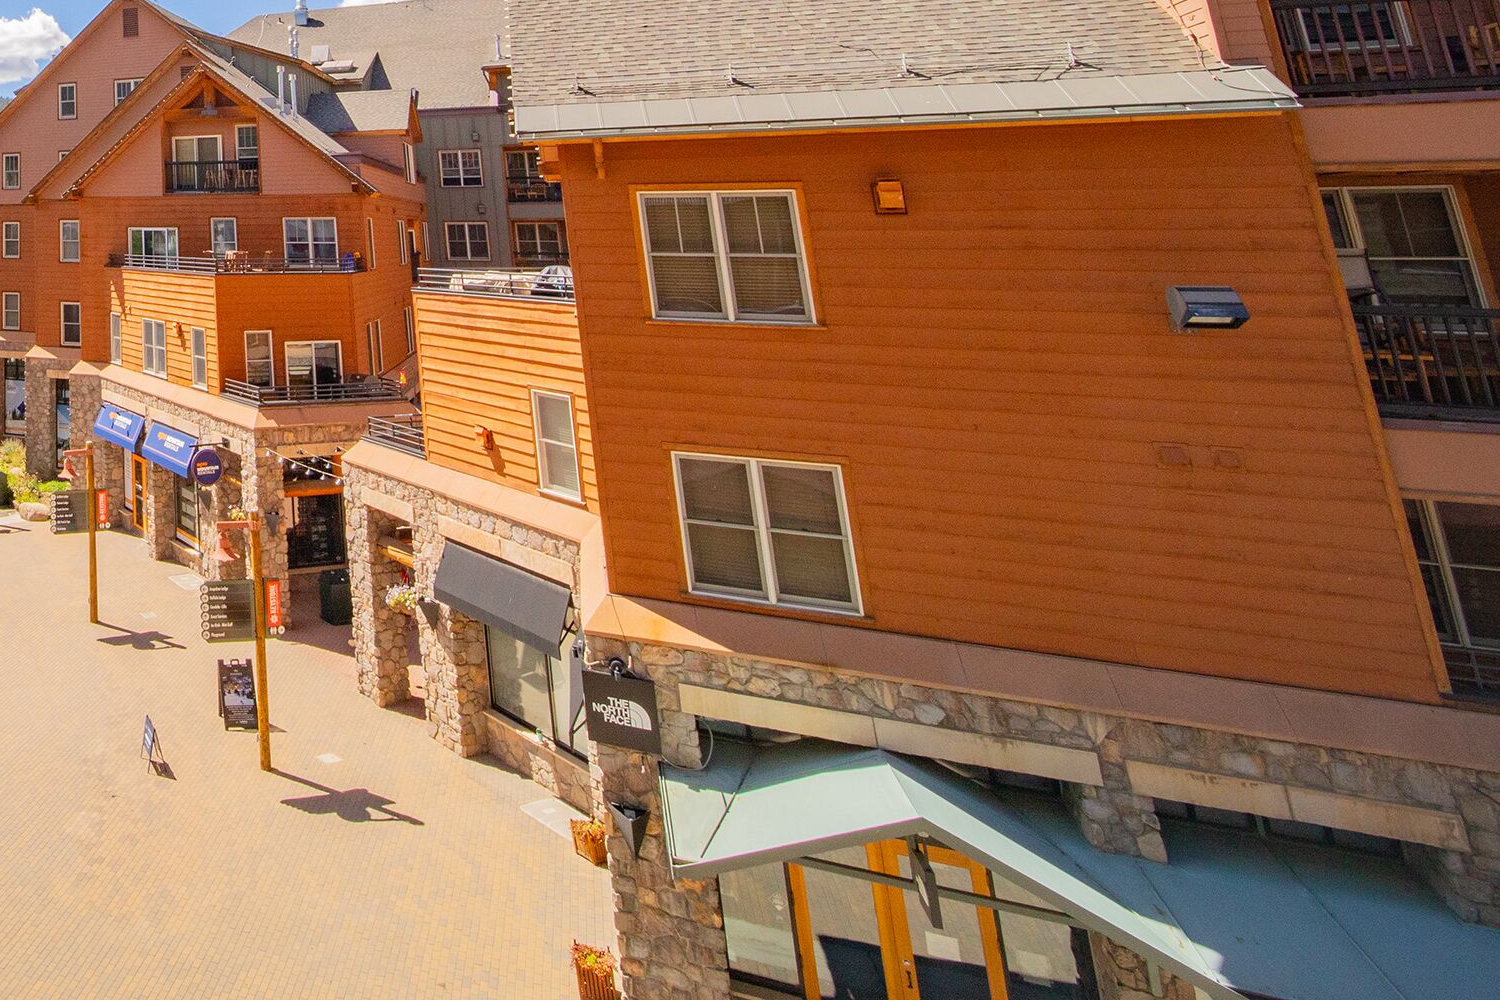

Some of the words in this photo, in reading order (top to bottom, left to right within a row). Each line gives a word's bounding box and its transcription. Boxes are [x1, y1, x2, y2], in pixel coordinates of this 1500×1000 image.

[607, 696, 629, 708] THE
[592, 702, 630, 717] NORTH
[604, 713, 631, 726] FACE
